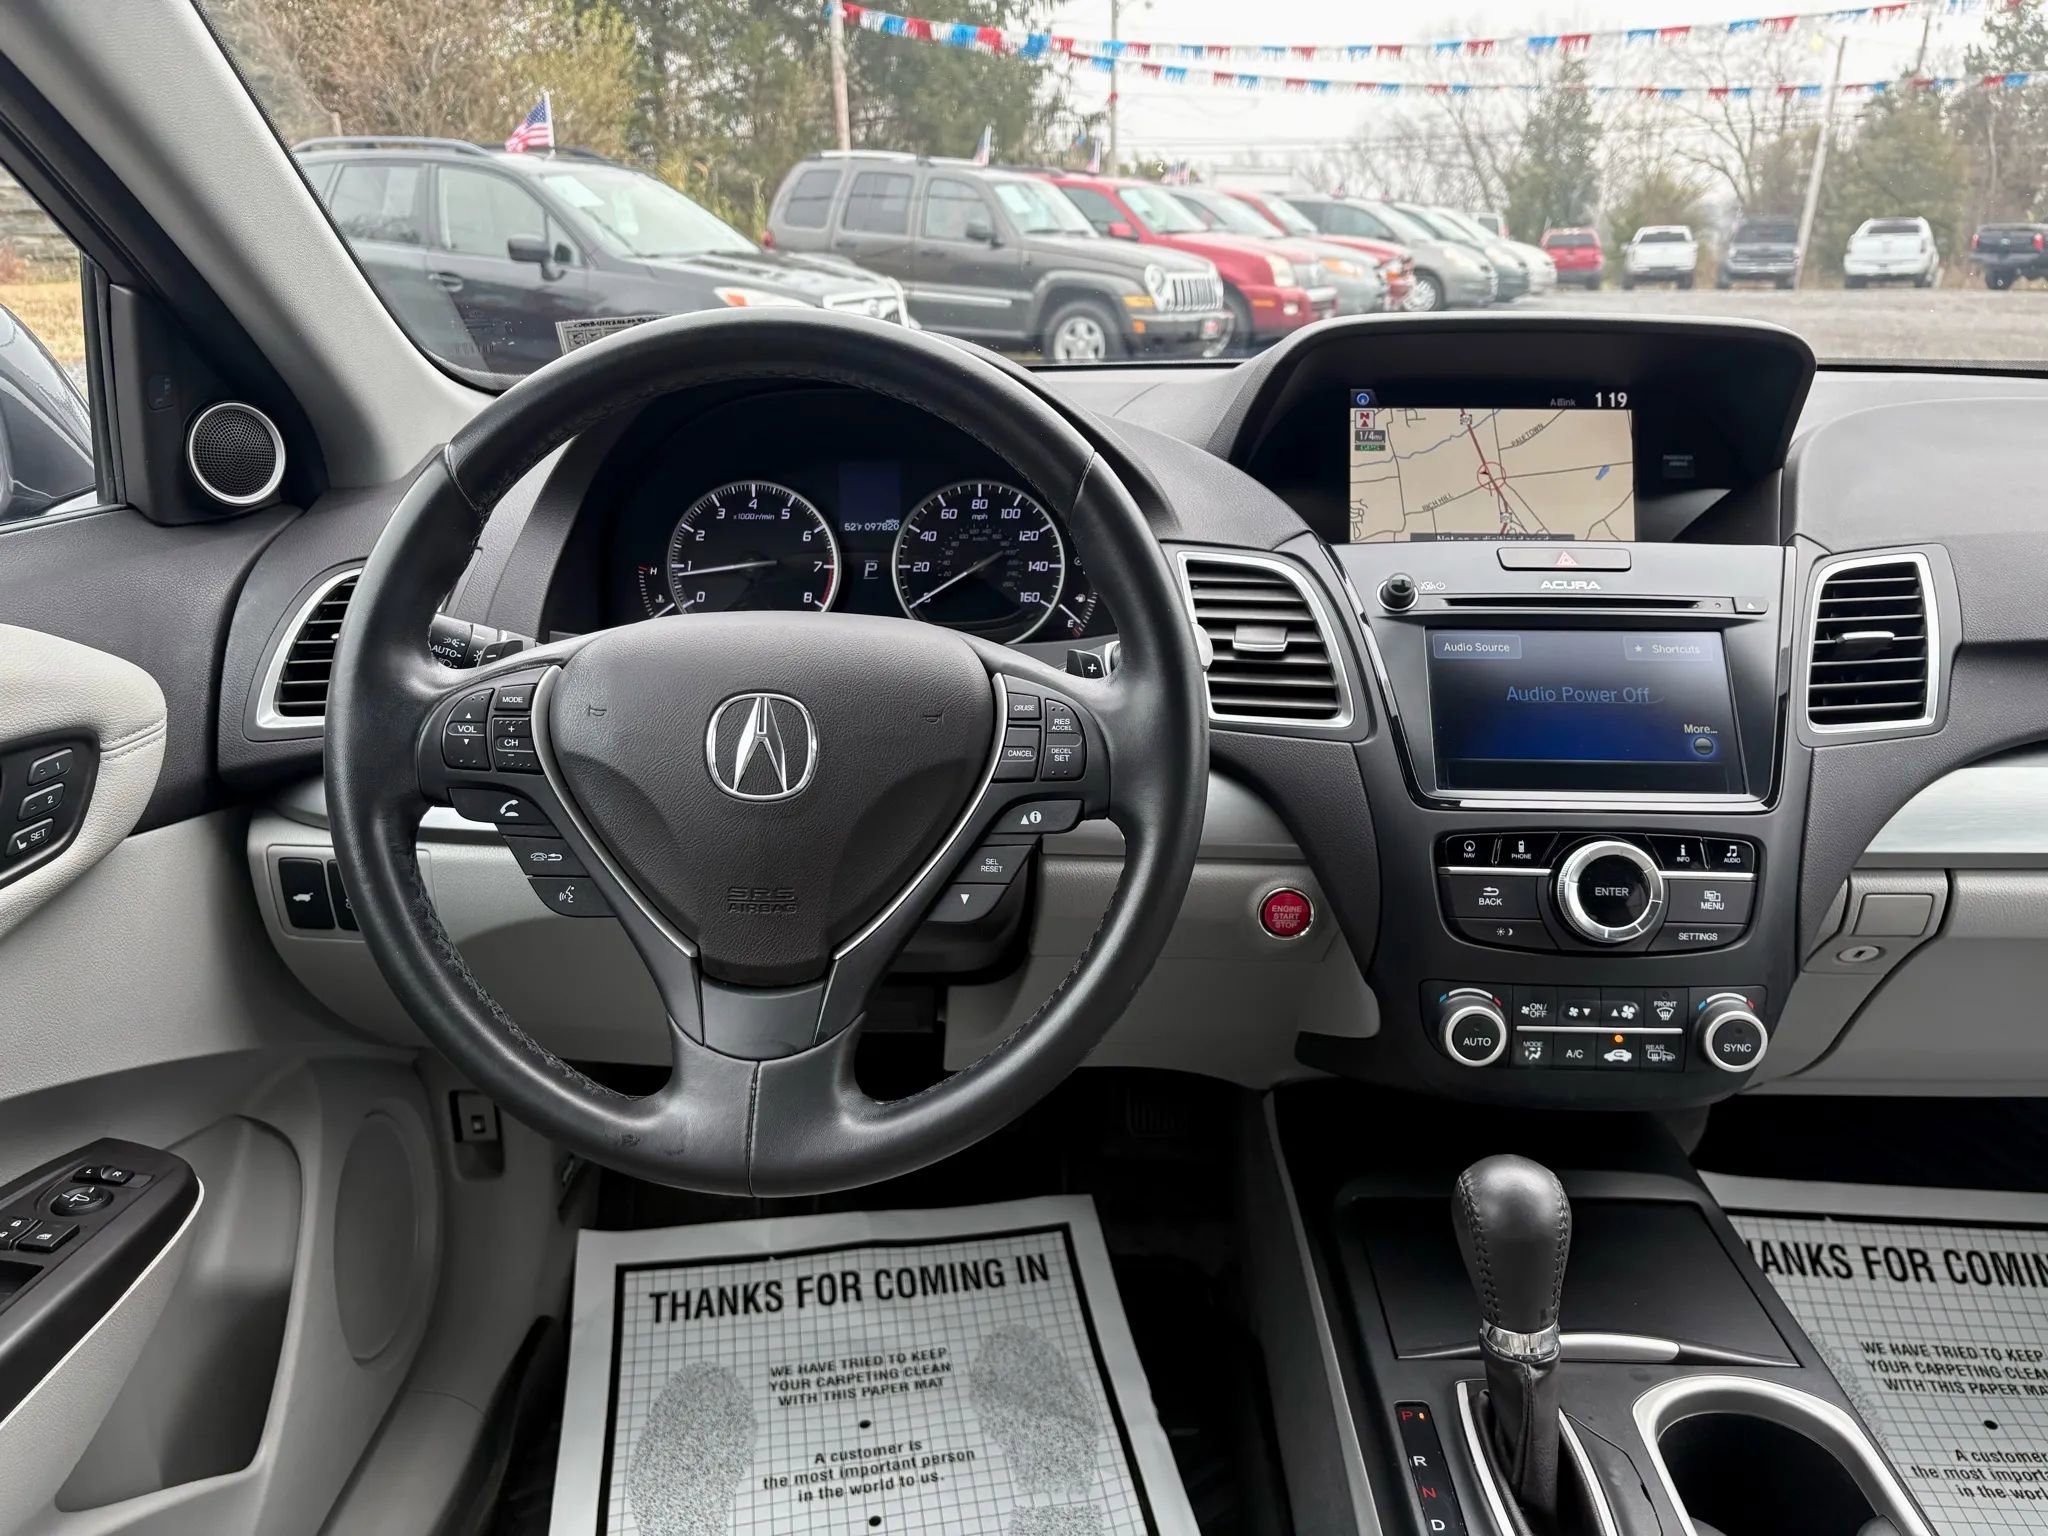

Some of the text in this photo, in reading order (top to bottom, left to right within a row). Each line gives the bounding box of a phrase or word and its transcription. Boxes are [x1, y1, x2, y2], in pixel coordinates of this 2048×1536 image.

[749, 499, 758, 509] 4
[971, 500, 988, 509] 80
[716, 509, 726, 519] 3
[781, 509, 790, 519] 5
[941, 509, 958, 519] 60
[1001, 509, 1021, 519] 100
[865, 523, 900, 531] 097820
[696, 530, 705, 541] 2
[803, 531, 812, 541] 6
[920, 531, 937, 541] 40
[1019, 531, 1039, 541] 120
[687, 560, 691, 571] 1
[814, 562, 822, 573] 7
[864, 561, 879, 579] P
[913, 562, 930, 572] 20
[1028, 561, 1048, 572] 140
[1540, 580, 1601, 590] ACURA
[697, 592, 705, 602] 0
[804, 592, 812, 603] 8
[1020, 592, 1040, 602] 160
[1068, 620, 1074, 628] E
[432, 645, 457, 657] AUTO
[1444, 642, 1510, 653] Audio Source
[1652, 644, 1700, 655] Shortcuts
[1506, 686, 1650, 703] Audio Power Off
[458, 725, 477, 733] VOL
[504, 738, 519, 747] CH
[1054, 754, 1070, 762] SET
[47, 795, 54, 804] 2
[30, 828, 46, 841] SET
[981, 865, 1003, 873] RESET
[1595, 887, 1629, 897] ENTER
[1478, 898, 1502, 906] BACK
[1700, 901, 1725, 910] MENU
[728, 903, 797, 914] AIRBAG
[1678, 932, 1718, 942] SETTINGS
[1530, 1010, 1547, 1018] OFF
[1463, 1037, 1492, 1047] AUTO
[1723, 1043, 1752, 1053] SYNC
[1566, 1049, 1584, 1059] A/C
[1747, 1239, 2048, 1288] ANKS FOR COMIN
[649, 1253, 1050, 1323] THANKS FOR COMING IN
[1861, 1341, 2044, 1363] WE HAVE TRIED TO KEEP
[771, 1347, 947, 1378] WE HAVE TRIED TO KEEP
[1866, 1359, 1912, 1374] YOUR
[1914, 1362, 2001, 1378] CARPETING
[769, 1362, 951, 1392] YOUR CARPETING CLEAN
[778, 1377, 944, 1407] WITH THIS PAPER MAT
[1883, 1378, 1926, 1392] WITH
[1927, 1380, 1966, 1394] THIS
[1968, 1382, 2022, 1396] PAPER
[1402, 1411, 1413, 1420] P
[814, 1439, 923, 1464] A customer is
[1955, 1449, 2048, 1464] A customer
[1413, 1456, 1428, 1466] R
[763, 1450, 976, 1490] the most important person
[1911, 1465, 2048, 1484] the most import
[798, 1471, 945, 1502] in the world to us.
[1422, 1487, 1437, 1498] N
[1955, 1484, 2048, 1500] in the worl
[1431, 1520, 1445, 1530] D
